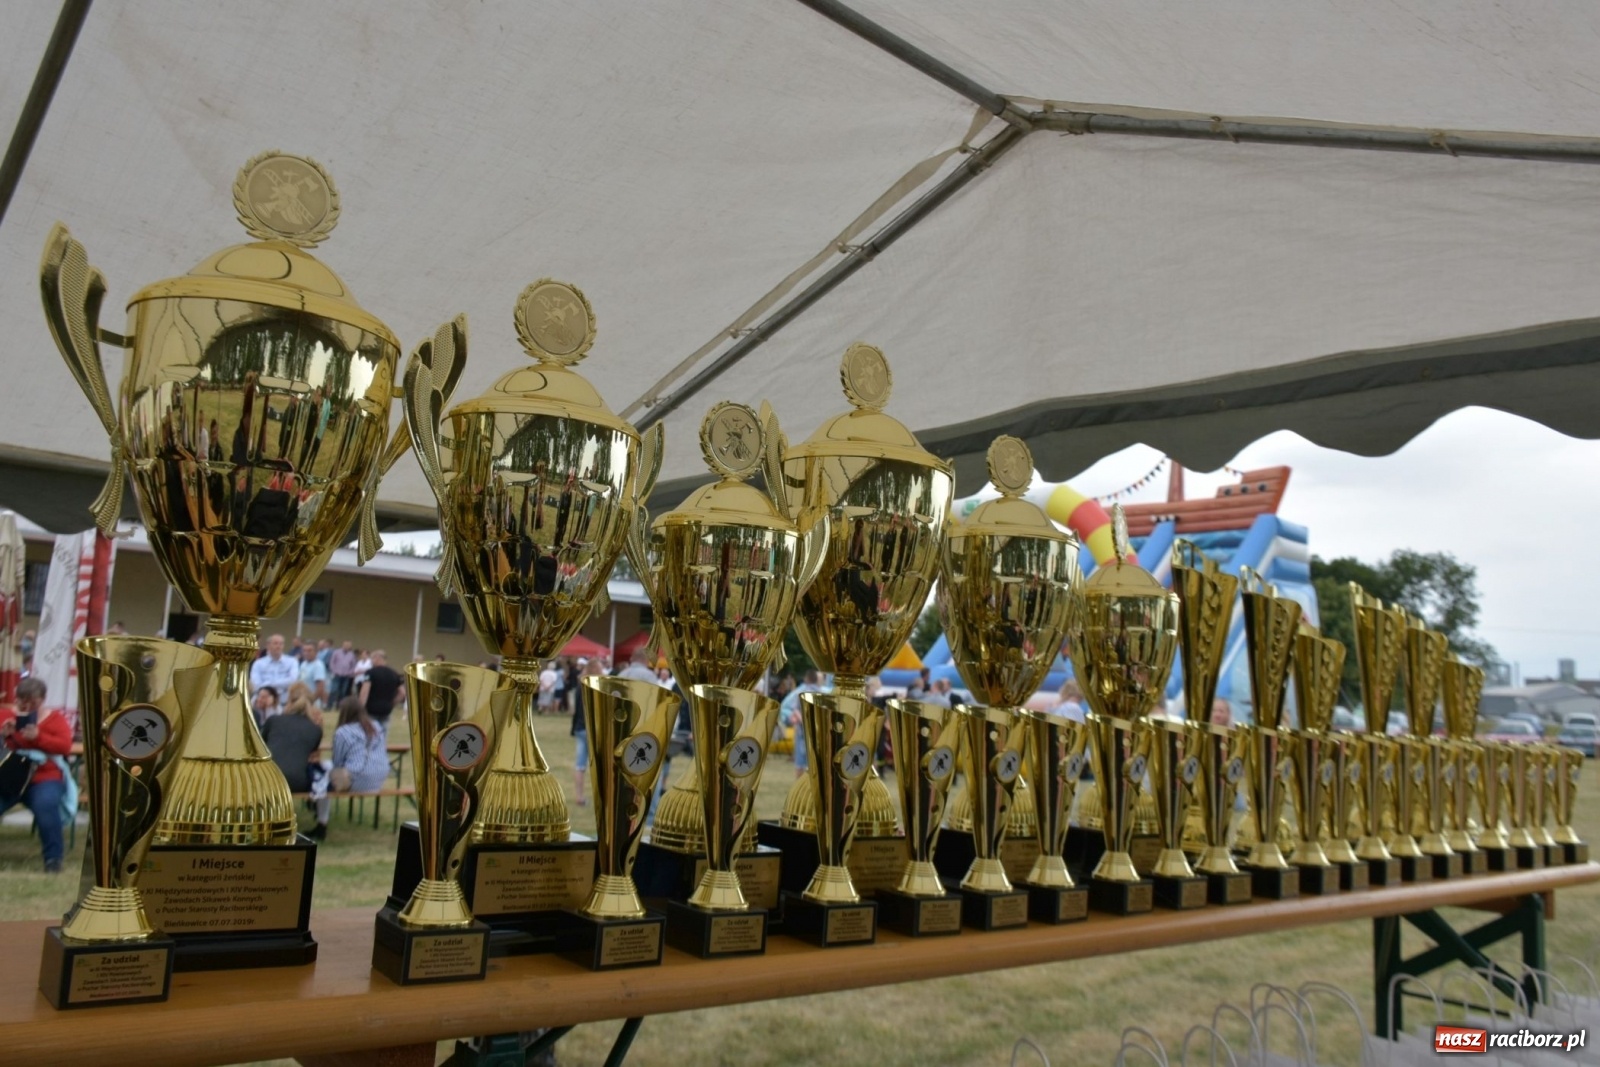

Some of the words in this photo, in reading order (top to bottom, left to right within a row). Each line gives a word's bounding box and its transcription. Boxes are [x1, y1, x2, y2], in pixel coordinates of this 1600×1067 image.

[192, 858, 197, 869] I
[199, 858, 245, 871] Miejsce
[526, 855, 557, 866] Miejsce
[186, 874, 222, 883] kategorii
[223, 873, 255, 882] żeńskiej
[243, 885, 289, 895] Powiatowych
[232, 895, 262, 903] Konnych
[155, 907, 161, 915] o
[162, 906, 187, 914] Puchar
[188, 905, 218, 914] Starosty
[219, 904, 268, 912] Raciborskiego
[164, 919, 207, 928] Bieńkowice
[101, 956, 111, 965] Za
[112, 954, 140, 964] udział
